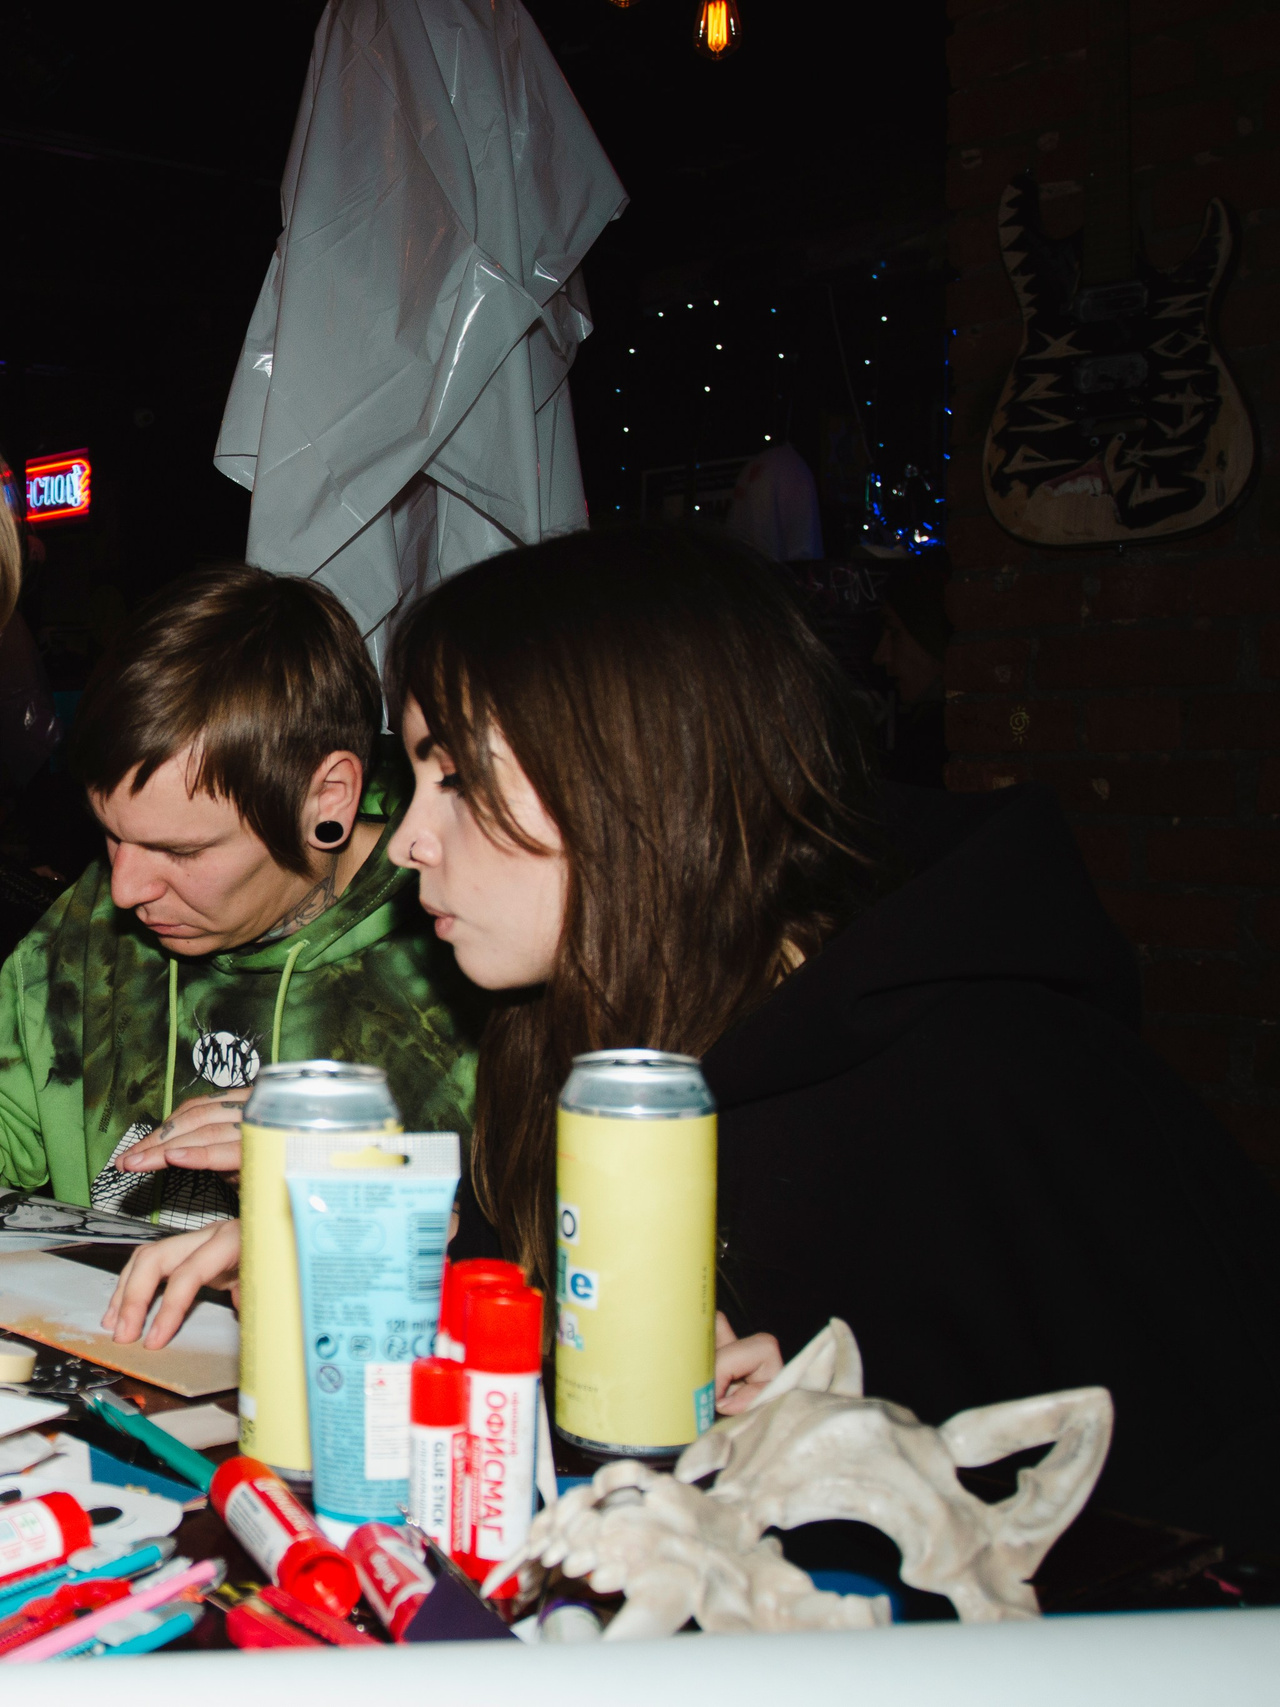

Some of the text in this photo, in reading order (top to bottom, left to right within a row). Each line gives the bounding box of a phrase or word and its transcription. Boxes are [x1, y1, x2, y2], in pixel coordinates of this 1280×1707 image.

[433, 1441, 446, 1527] GLUE STICK
[483, 1389, 508, 1545] ОФИСМАГ
